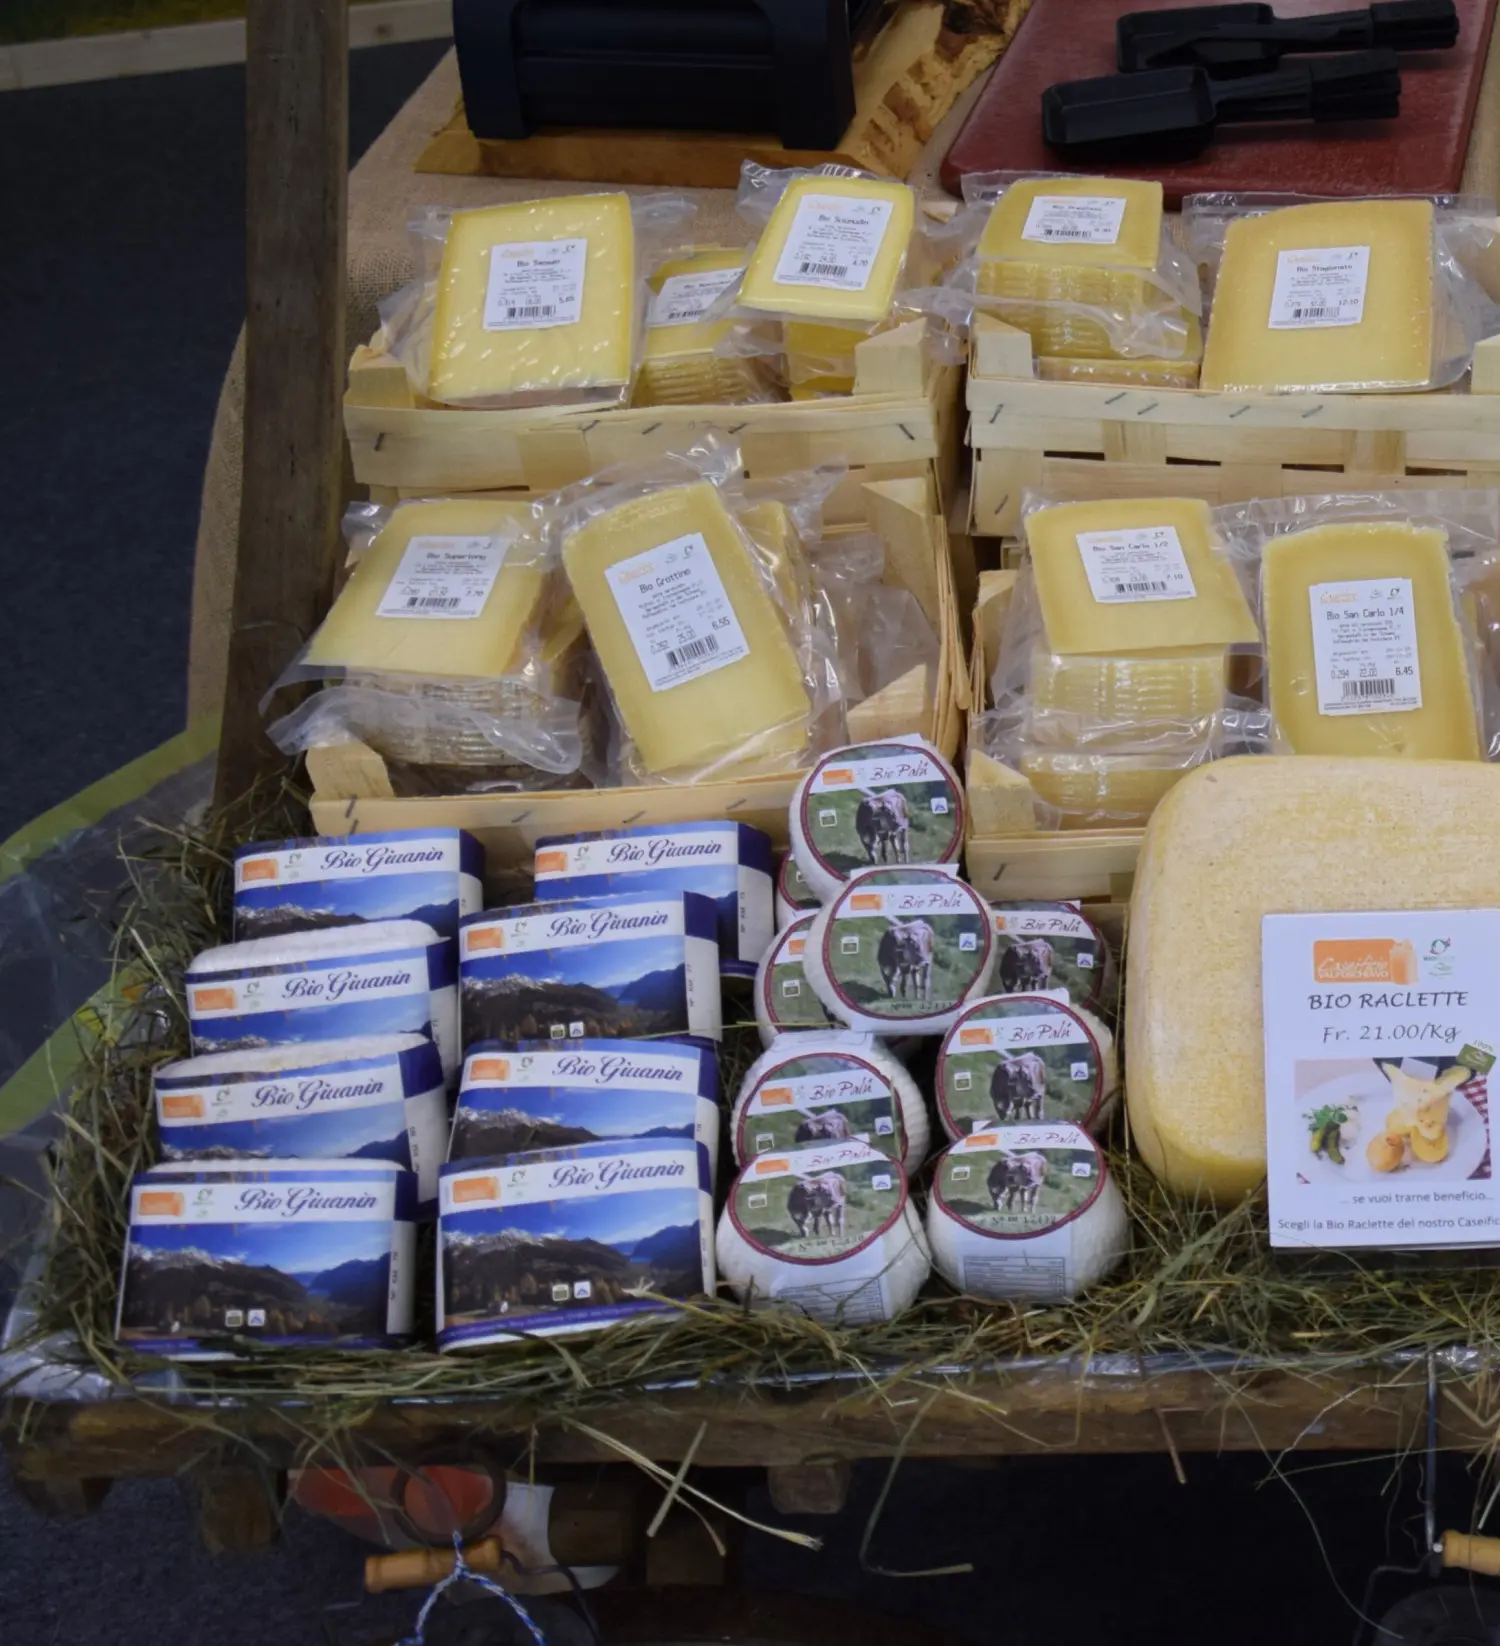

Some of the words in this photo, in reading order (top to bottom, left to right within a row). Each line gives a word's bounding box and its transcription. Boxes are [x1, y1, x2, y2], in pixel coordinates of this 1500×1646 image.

[638, 580, 654, 594] Bio
[655, 568, 691, 587] Grottino
[1326, 611, 1340, 621] Bio
[1344, 610, 1360, 620] San
[1363, 608, 1386, 619] Carlo
[1389, 606, 1405, 616] 1/4
[1395, 666, 1414, 677] 6.45
[870, 767, 893, 780] Bio
[320, 850, 361, 870] Bio
[607, 843, 643, 863] Bio
[899, 895, 925, 909] Bio
[546, 917, 587, 938] Bio
[1021, 918, 1045, 930] Bio
[282, 977, 324, 999] Bio
[1308, 994, 1351, 1010] BIO
[1358, 991, 1469, 1009] RACLETTE
[1008, 1027, 1034, 1042] Bio
[1322, 1026, 1350, 1043] Fr.
[1360, 1023, 1461, 1043] 21.00/Kg
[552, 1056, 596, 1076] Bio
[252, 1085, 295, 1108] Bio
[809, 1085, 836, 1100] Bio
[1013, 1133, 1041, 1145] Bio
[549, 1165, 594, 1188] Bio
[234, 1188, 282, 1211] Bio
[1353, 1195, 1366, 1203] se
[1369, 1193, 1392, 1203] vuoi
[1395, 1193, 1431, 1202] trarne
[1278, 1219, 1311, 1231] Scegli
[1314, 1219, 1323, 1230] la
[1326, 1219, 1345, 1230] Bio
[1348, 1218, 1394, 1230] Raclette
[1397, 1218, 1415, 1228] del
[1418, 1218, 1455, 1228] nostro
